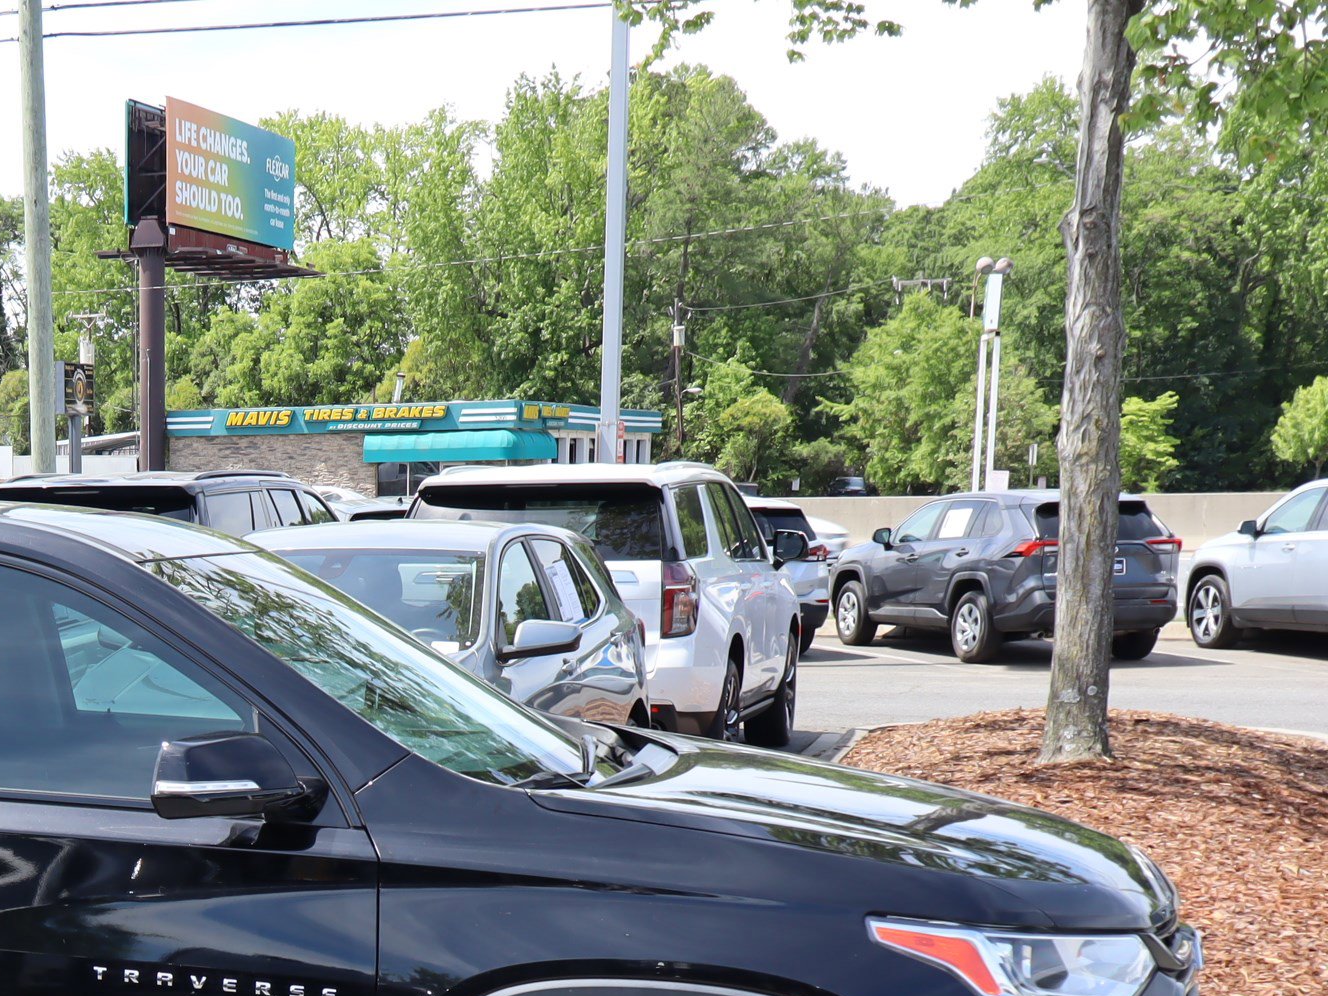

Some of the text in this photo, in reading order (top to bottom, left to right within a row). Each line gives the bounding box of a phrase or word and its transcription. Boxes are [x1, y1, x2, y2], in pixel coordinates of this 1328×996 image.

[175, 118, 251, 165] LIFE CHANGES.
[175, 148, 229, 187] YOUR CAR
[265, 156, 290, 180] FLEXCAR
[175, 180, 244, 221] SHOULD TOO.
[226, 405, 447, 427] MAVIS TIRES & BRAKES
[337, 422, 382, 430] DISCOUNT
[384, 421, 418, 429] PRICES
